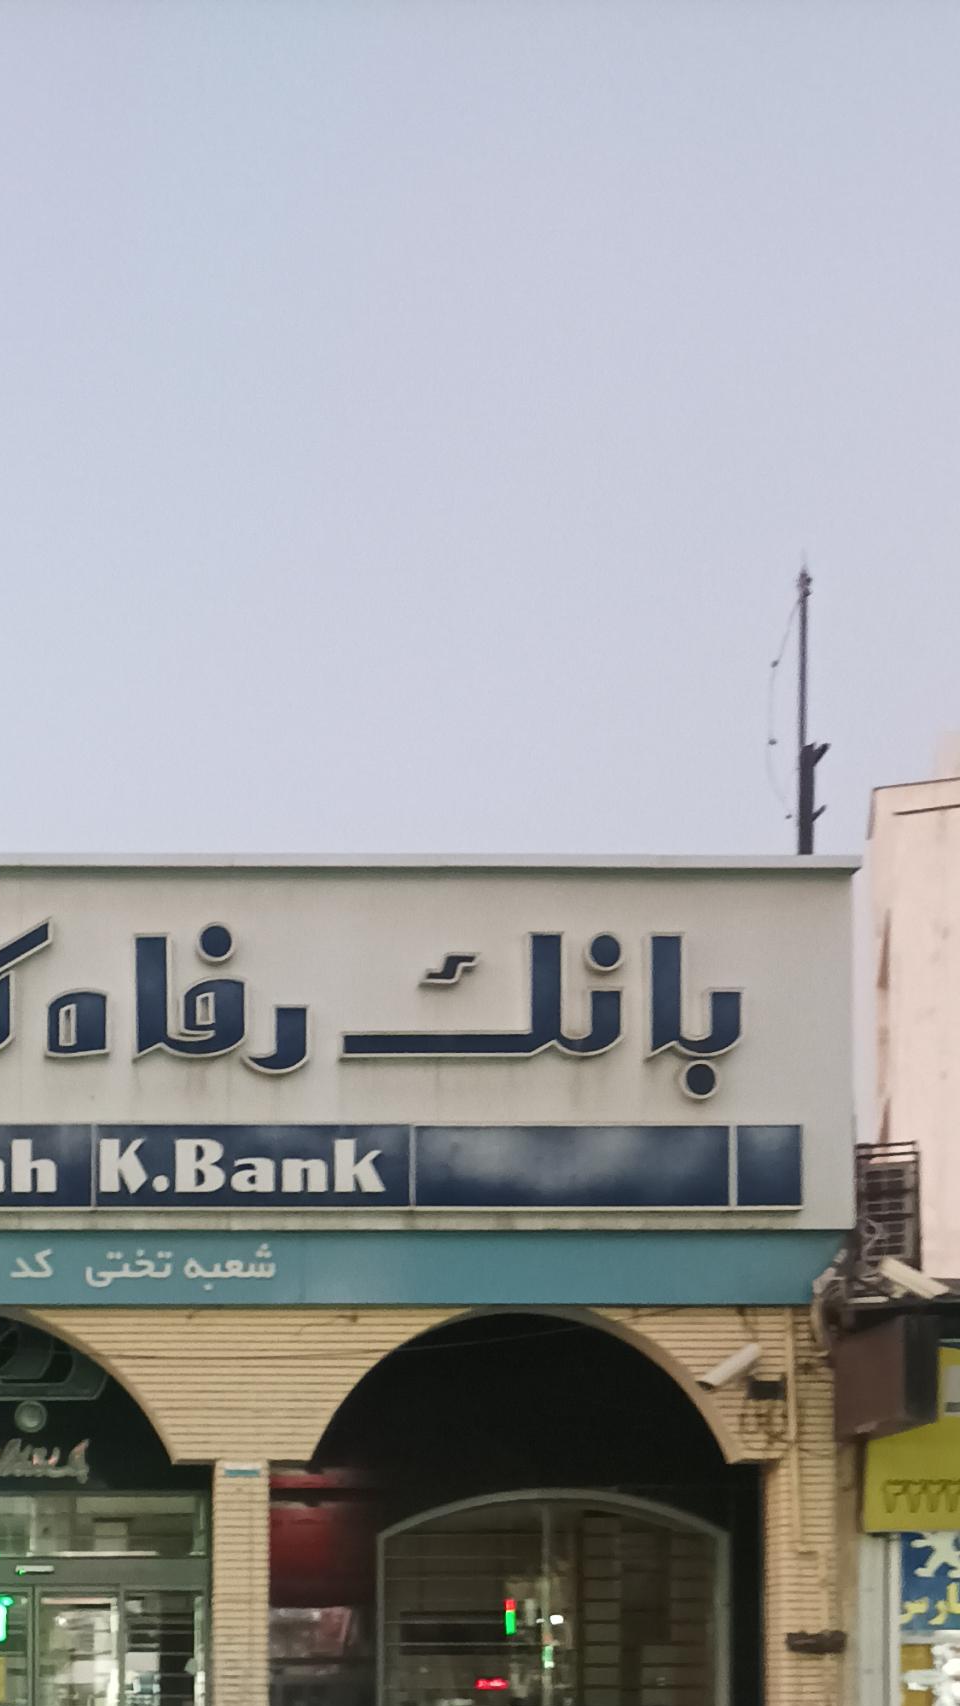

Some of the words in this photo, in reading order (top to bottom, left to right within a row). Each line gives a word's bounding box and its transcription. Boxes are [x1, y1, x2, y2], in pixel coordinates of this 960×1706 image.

[43, 920, 311, 1075] رفاه
[340, 929, 744, 1100] بانک
[9, 1248, 55, 1279] کد
[84, 1248, 174, 1288] تختی
[182, 1242, 277, 1291] شعبه
